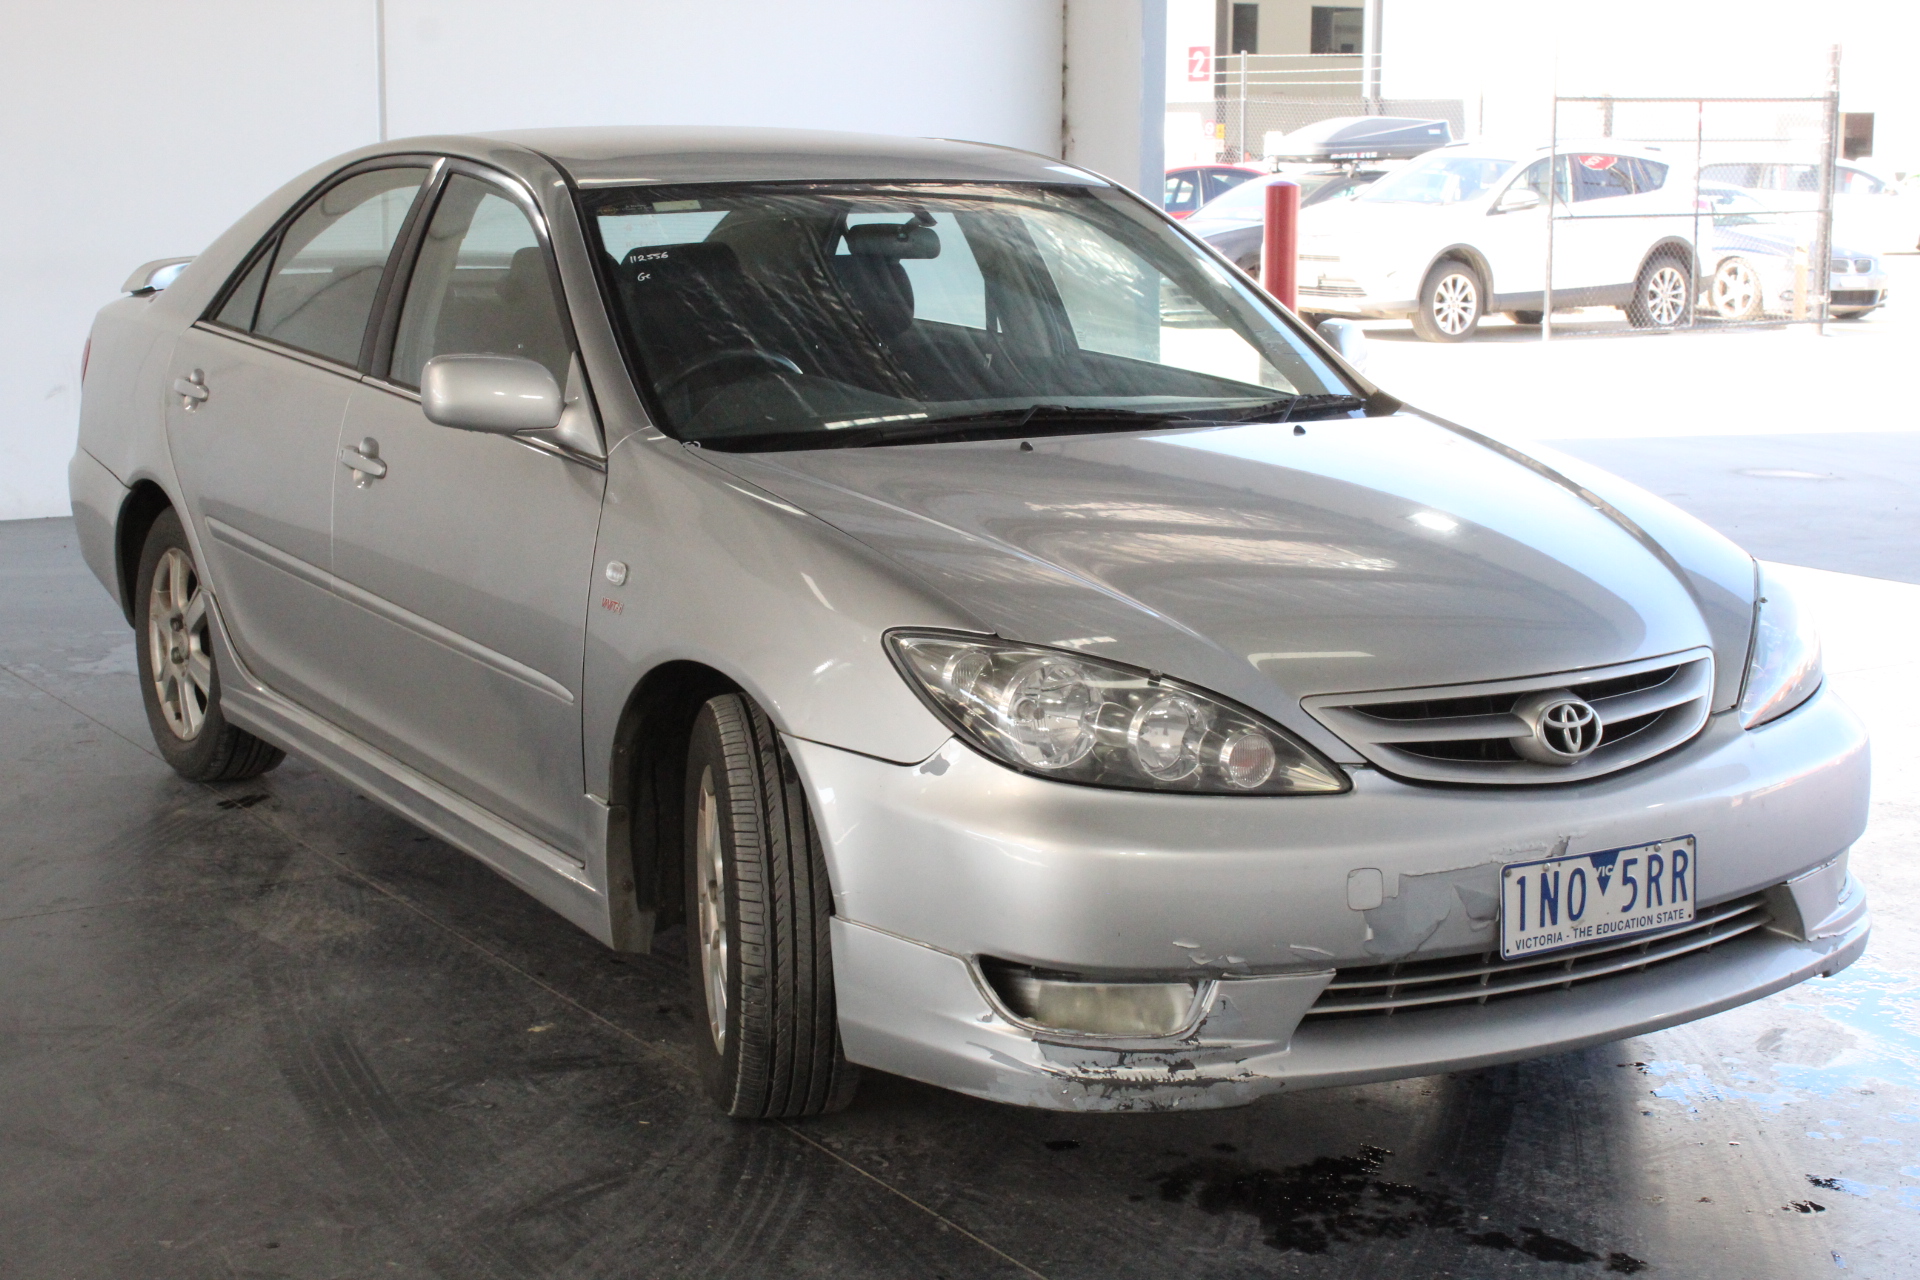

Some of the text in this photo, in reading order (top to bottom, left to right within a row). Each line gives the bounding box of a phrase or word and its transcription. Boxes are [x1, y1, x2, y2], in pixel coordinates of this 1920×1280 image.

[1192, 50, 1205, 78] 2
[630, 251, 669, 264] 112556
[1594, 864, 1615, 878] VIC
[1516, 849, 1689, 932] 1NO 5RR
[1515, 931, 1563, 951] VICTORIA
[1573, 925, 1593, 939] THE
[1596, 914, 1654, 935] EDUCATION
[1656, 908, 1685, 924] STATE
